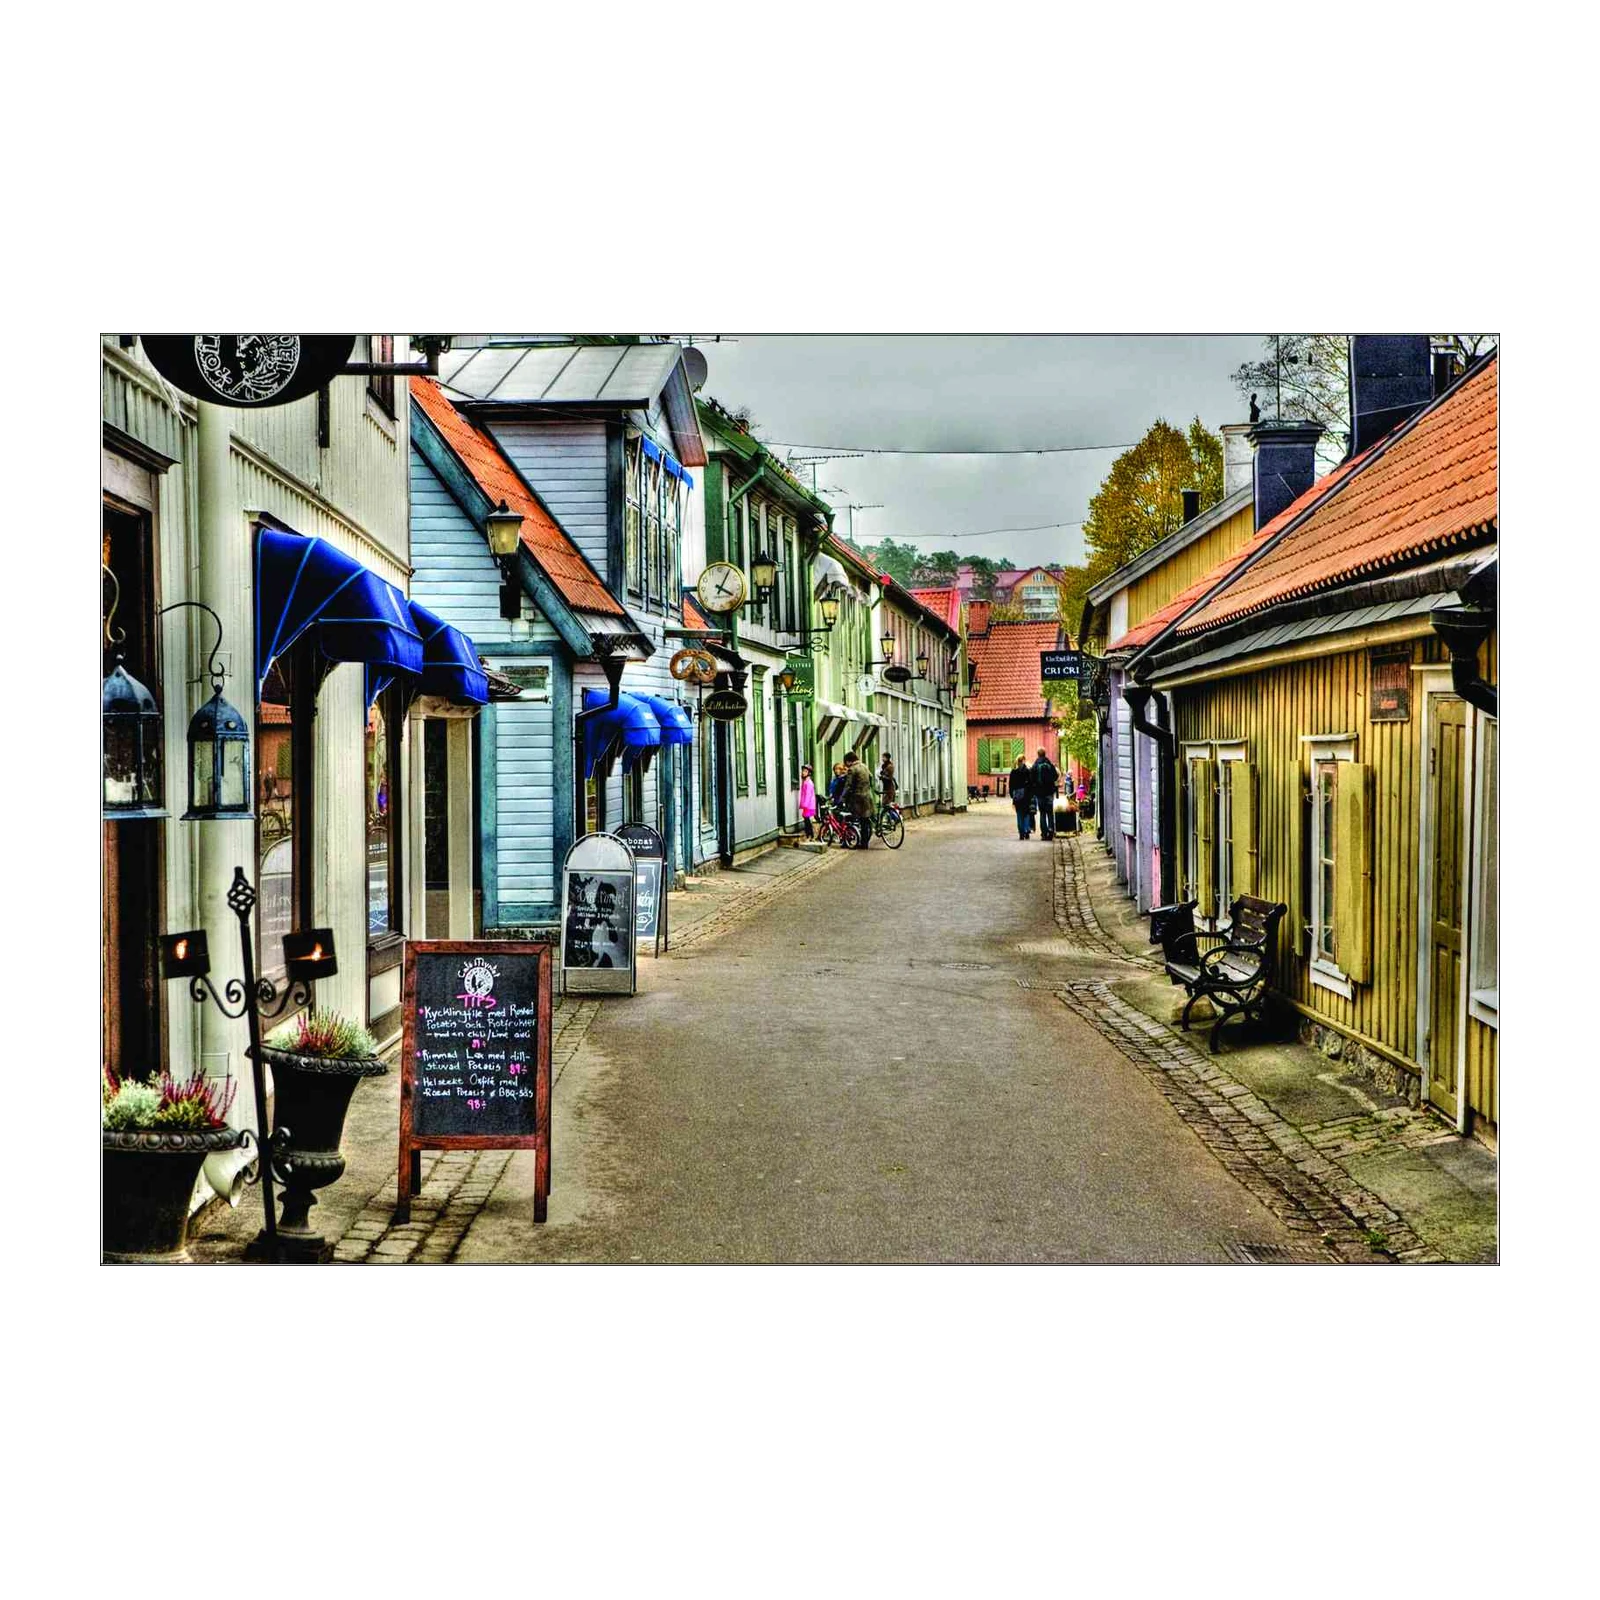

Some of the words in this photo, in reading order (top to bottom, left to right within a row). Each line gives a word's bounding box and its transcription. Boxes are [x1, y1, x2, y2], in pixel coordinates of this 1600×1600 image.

[1044, 667, 1061, 675] CRI
[1062, 666, 1080, 674] CRI
[456, 994, 496, 1008] TIPS
[487, 1050, 506, 1060] med
